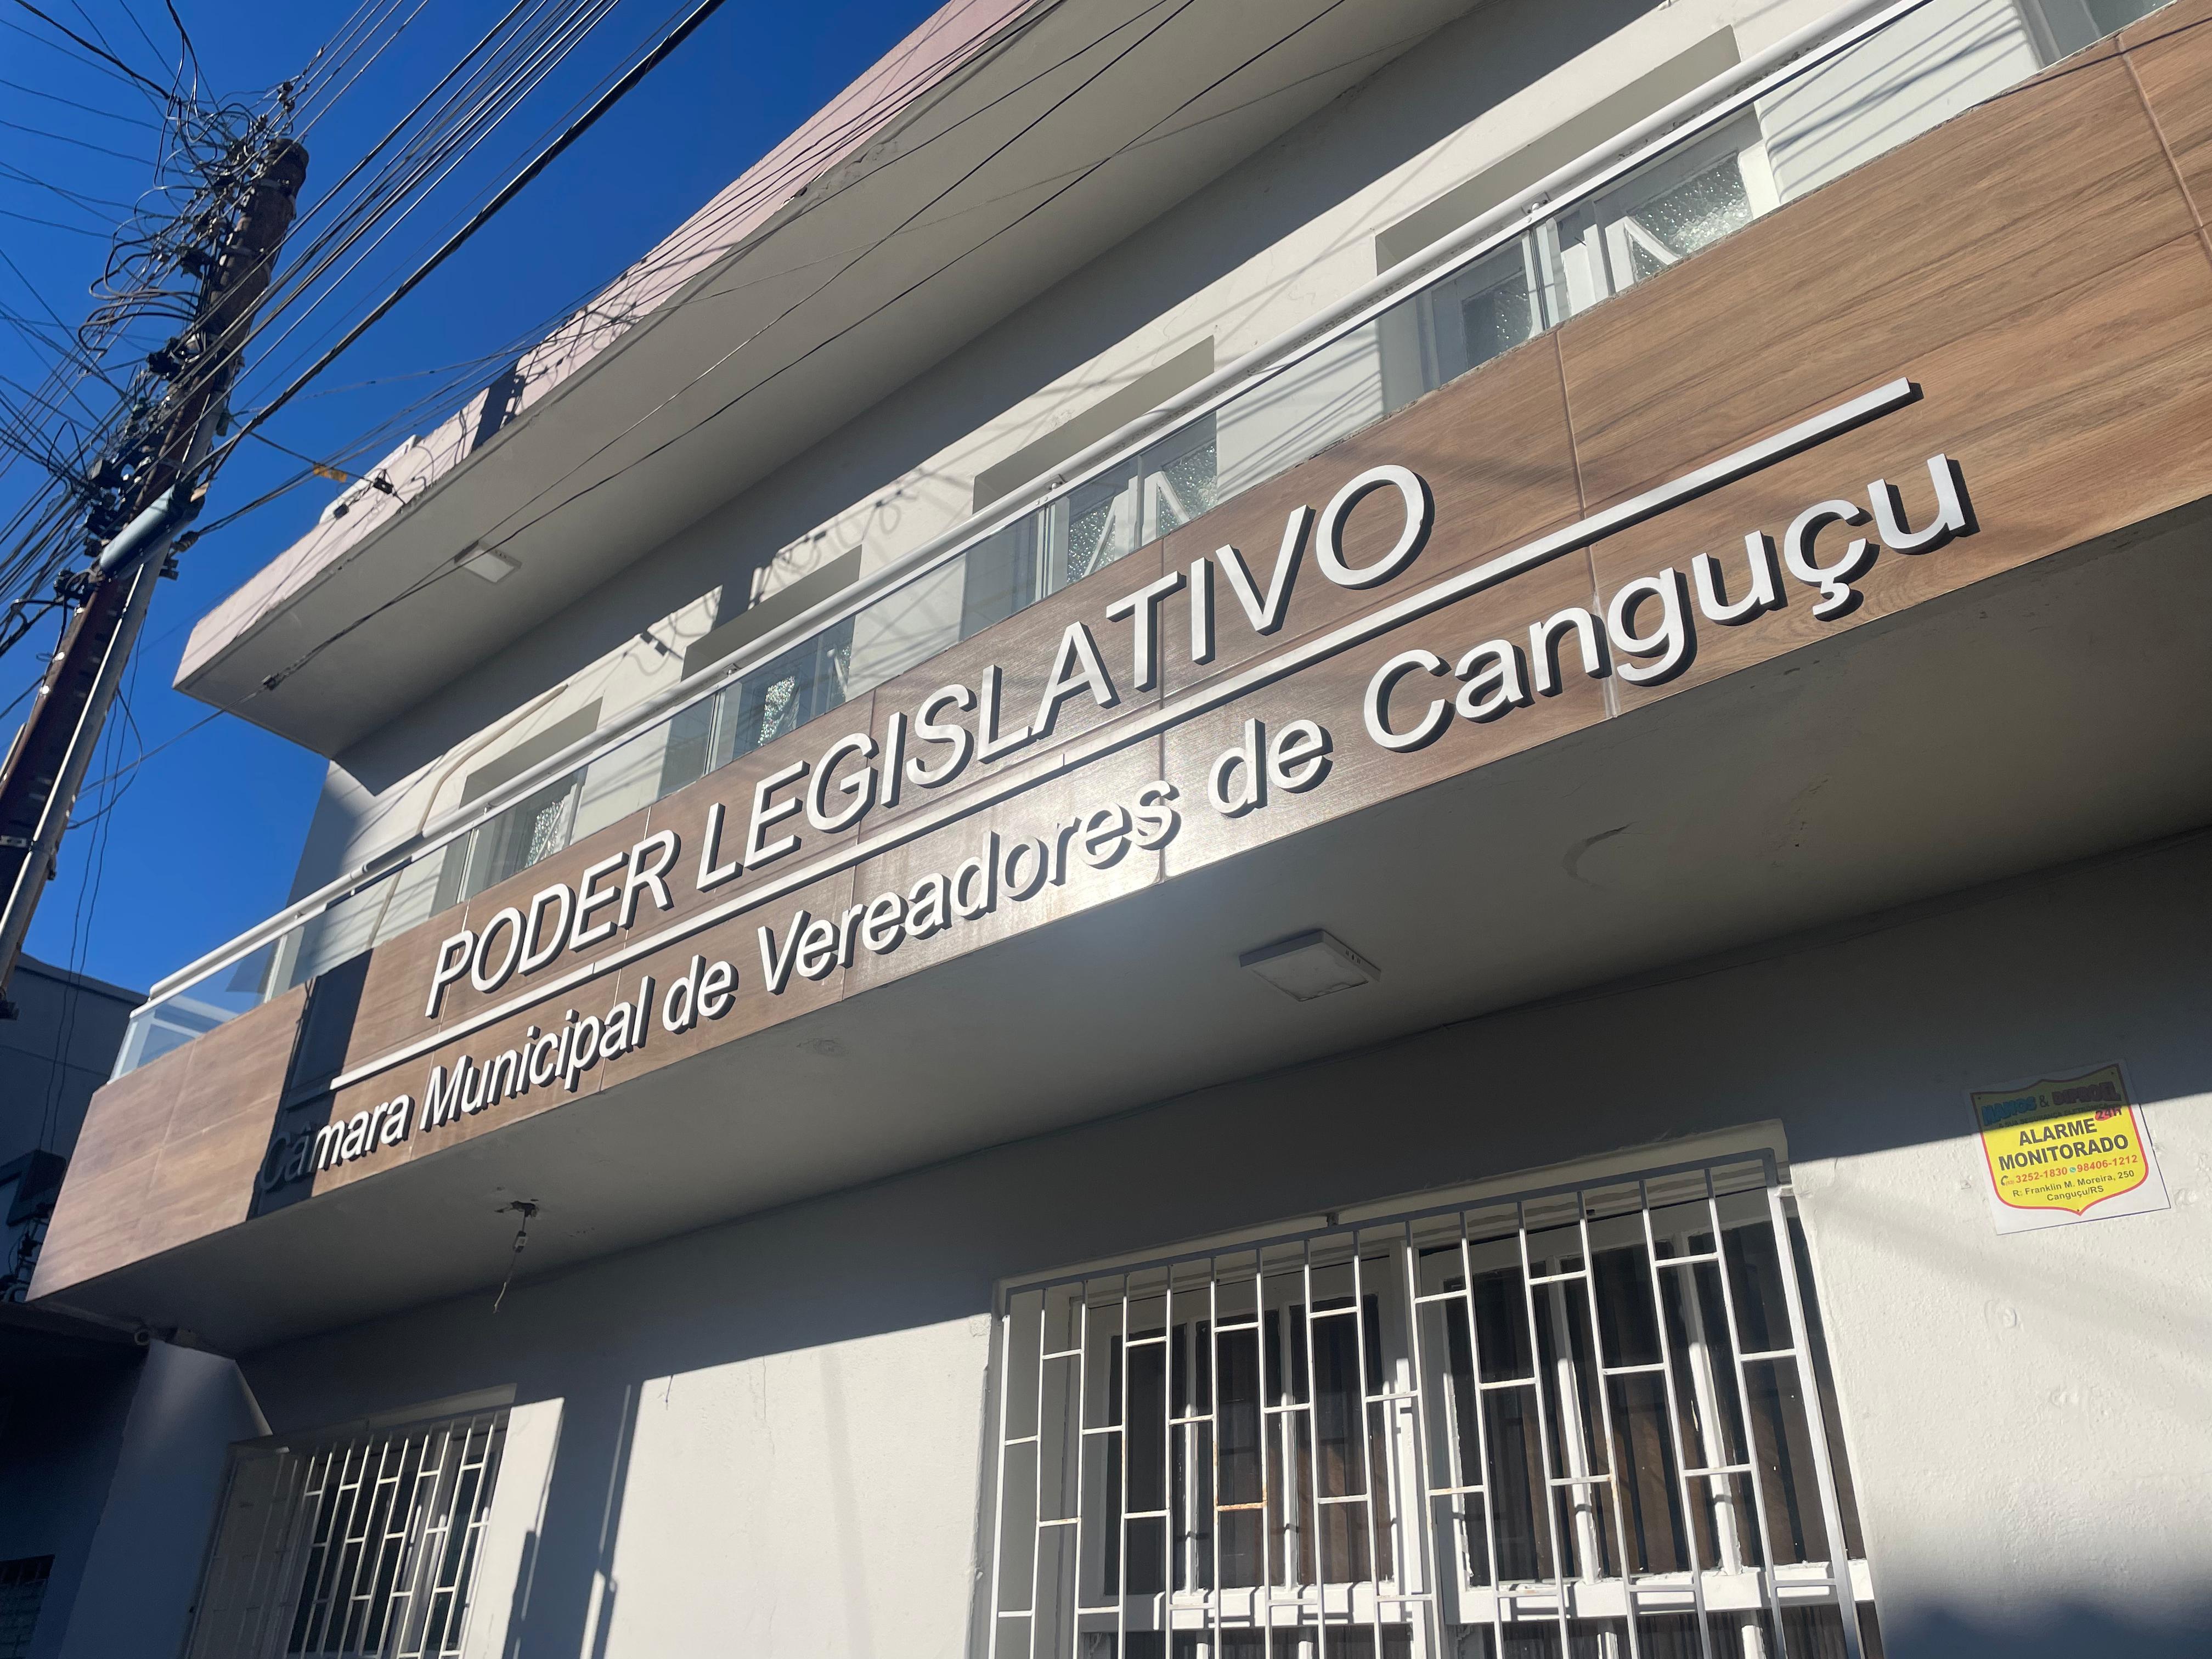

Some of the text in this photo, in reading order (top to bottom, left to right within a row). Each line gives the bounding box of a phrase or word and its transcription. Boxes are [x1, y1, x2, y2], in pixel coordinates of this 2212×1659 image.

[425, 465, 1431, 1017] PODER LEGISLATIVO
[255, 453, 1976, 1189] Câmara Municipal de Vereadores de Canguçu
[2019, 1118, 2097, 1146] ALARME
[1998, 1134, 2129, 1171] MONITORADO
[2016, 1167, 2068, 1183] 3252-1830
[2077, 1154, 2138, 1172] 98406-1212
[2025, 1182, 2062, 1195] Franklin
[2064, 1180, 2075, 1189] M.
[2077, 1173, 2116, 1186] Moreira,
[2118, 1170, 2135, 1180] 250
[2047, 1185, 2104, 1201] Canguçu/RS
